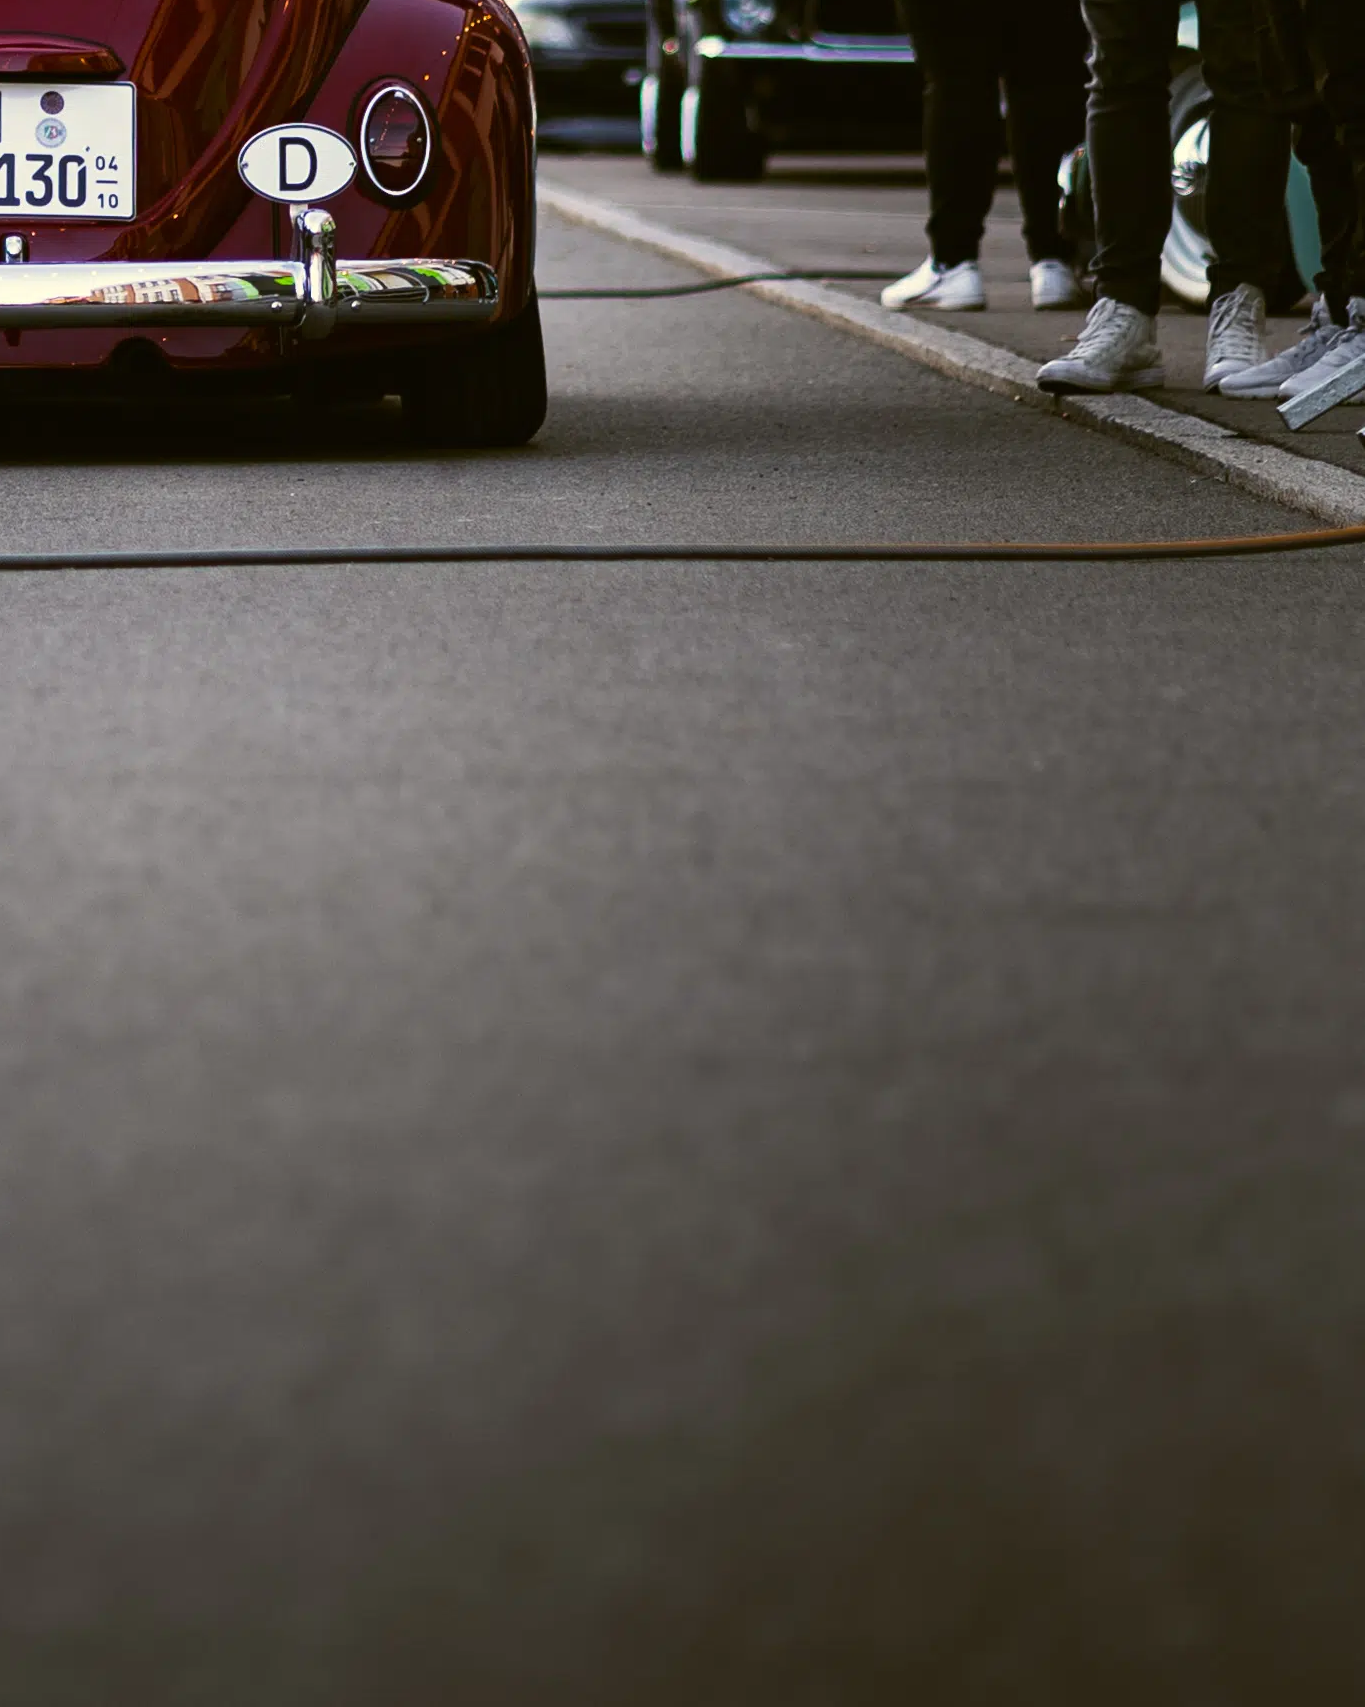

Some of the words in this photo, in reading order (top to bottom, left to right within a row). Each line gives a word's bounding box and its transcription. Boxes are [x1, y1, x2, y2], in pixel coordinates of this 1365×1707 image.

[94, 155, 119, 172] 04
[278, 136, 319, 192] D
[97, 193, 119, 209] 10
